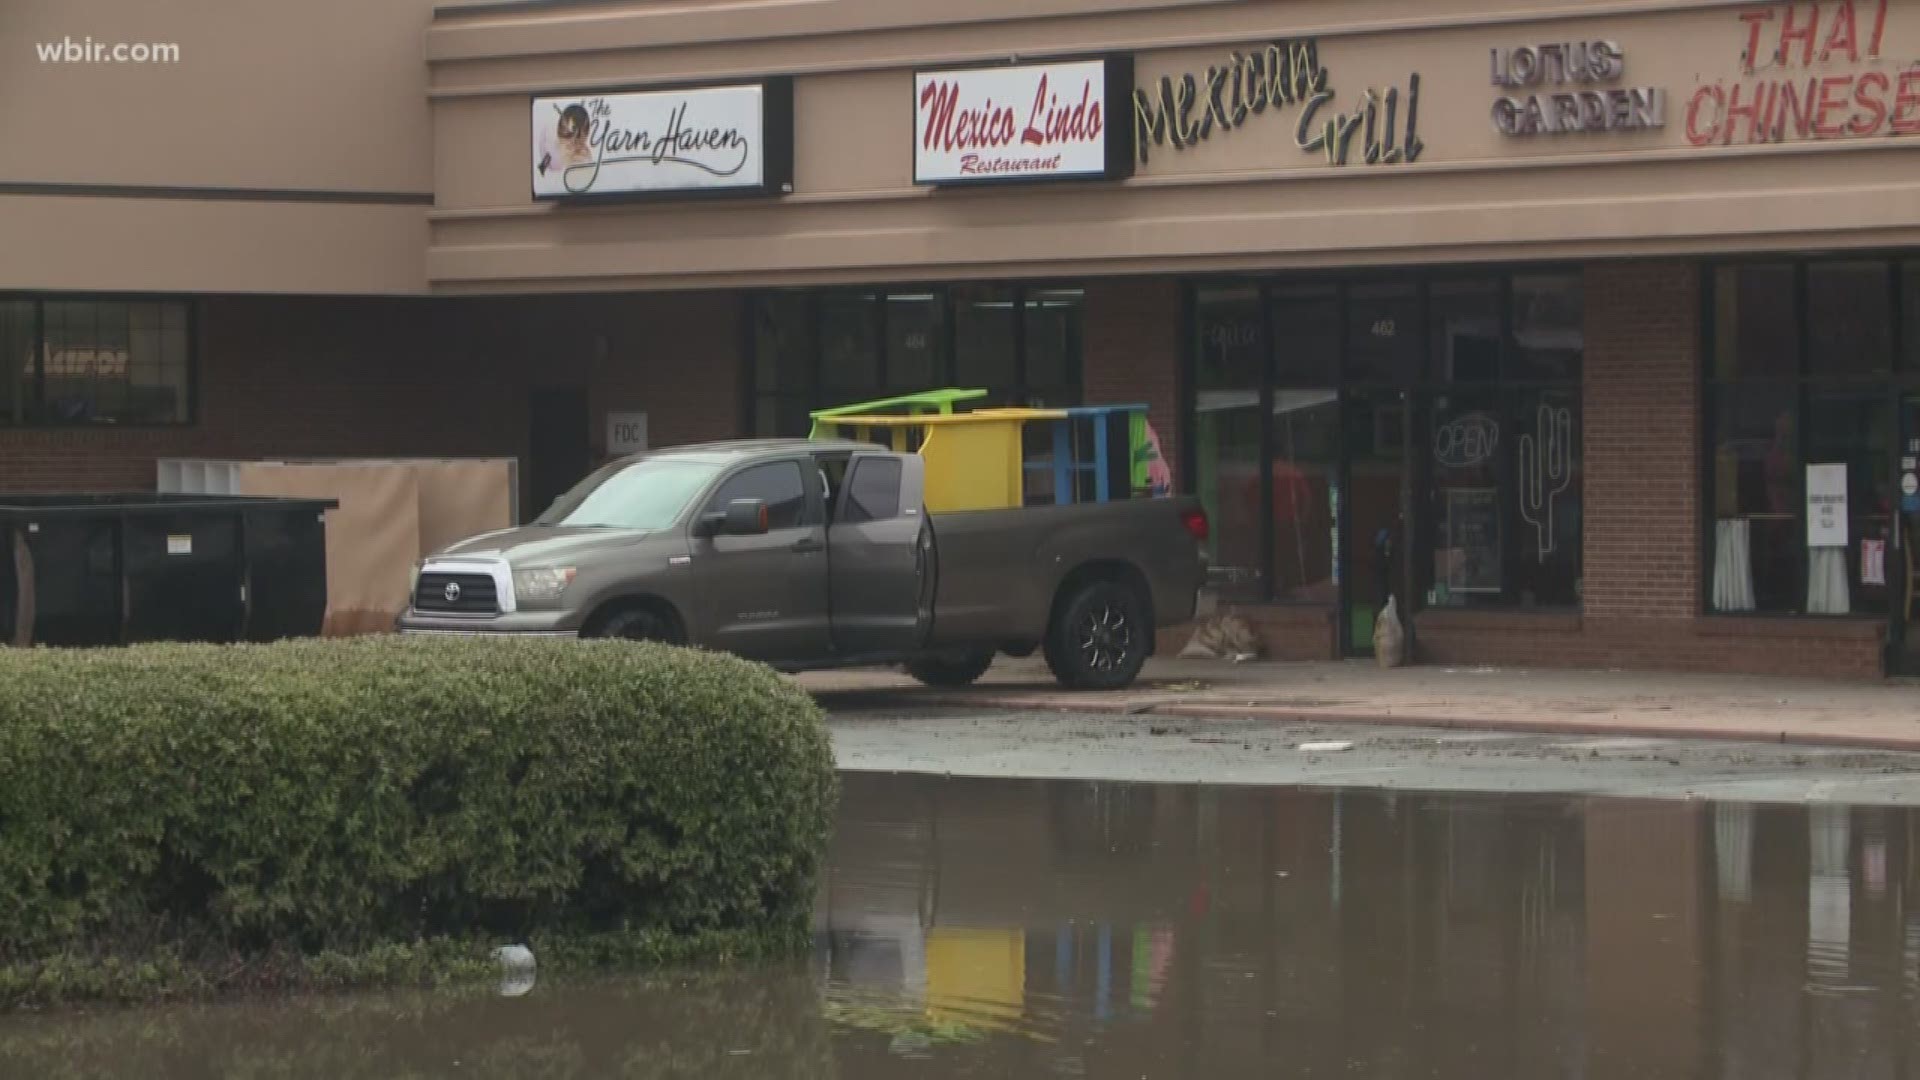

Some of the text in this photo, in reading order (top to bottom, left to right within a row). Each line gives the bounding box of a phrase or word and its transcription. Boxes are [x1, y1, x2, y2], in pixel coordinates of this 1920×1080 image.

[1490, 40, 1624, 87] LOTUS
[1739, 0, 1888, 75] THAI
[589, 98, 611, 117] The
[920, 72, 1104, 153] Mexico Lindo
[1132, 38, 1328, 164] Mexican
[1294, 71, 1424, 166] Grill
[1490, 86, 1666, 136] GARDEN
[1684, 71, 1920, 147] CHINESE
[652, 101, 748, 165] Haven
[960, 154, 1061, 176] Restaurant
[615, 423, 639, 441] FDC
[1435, 422, 1496, 458] OPEN
